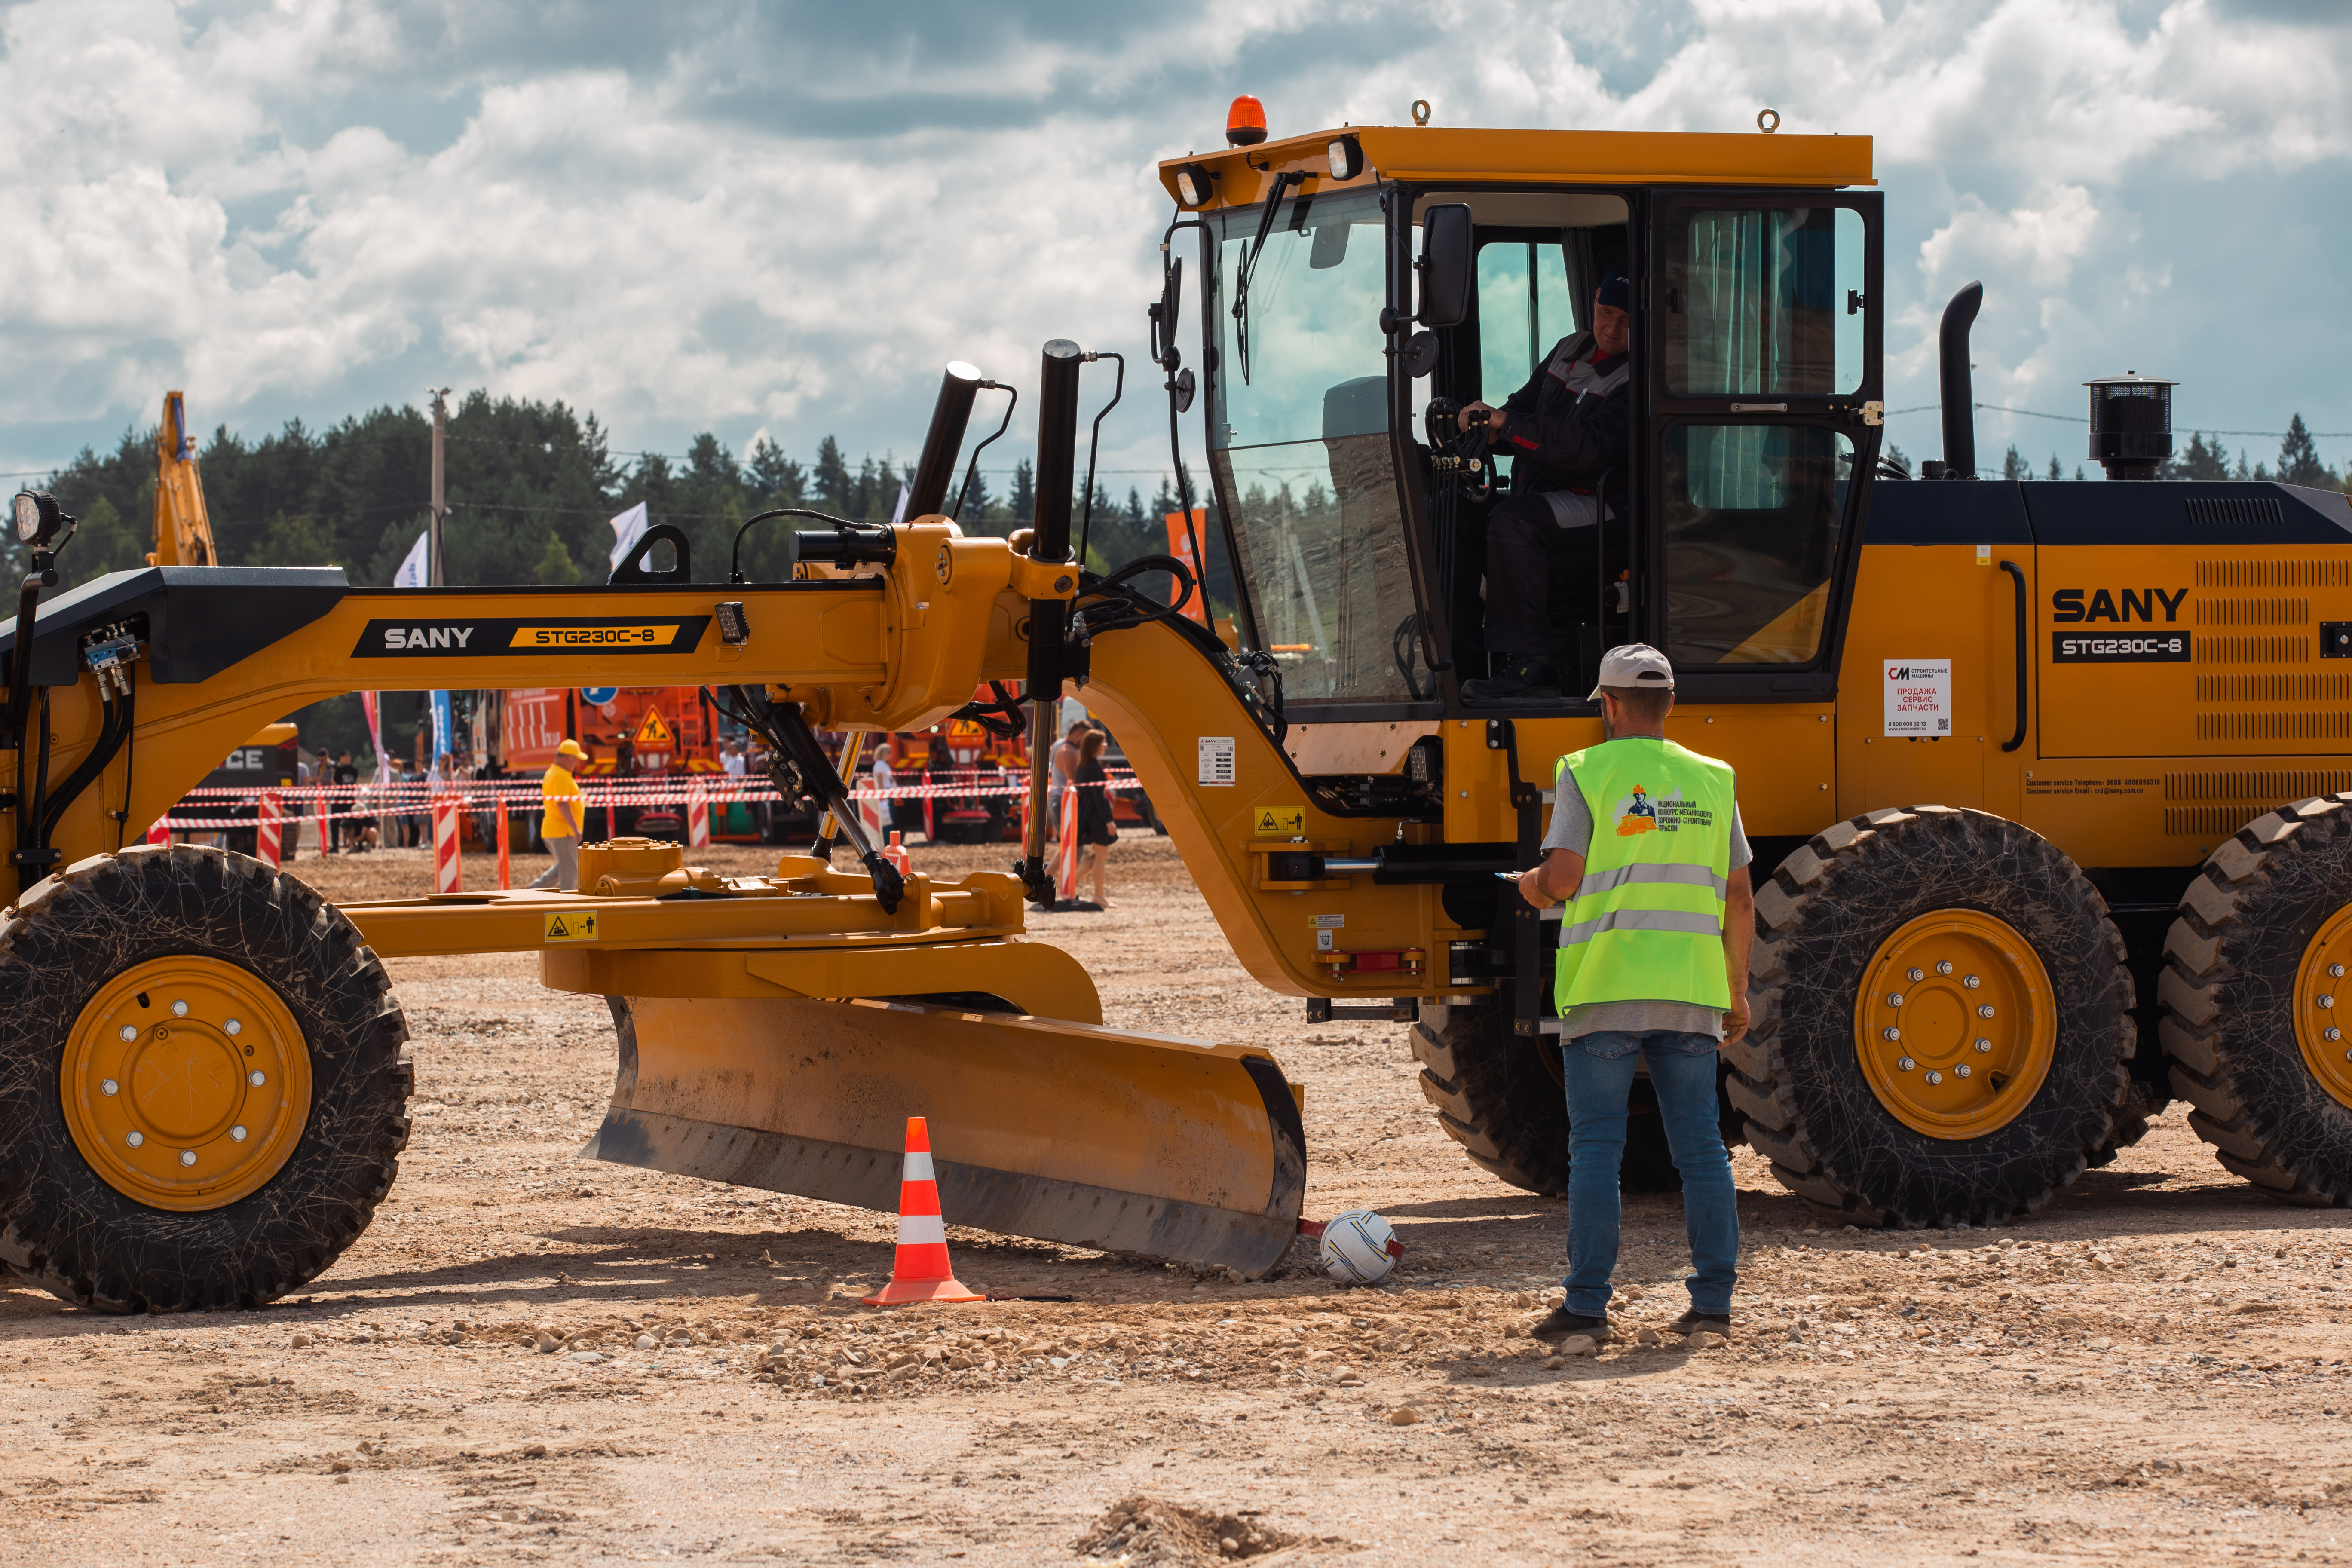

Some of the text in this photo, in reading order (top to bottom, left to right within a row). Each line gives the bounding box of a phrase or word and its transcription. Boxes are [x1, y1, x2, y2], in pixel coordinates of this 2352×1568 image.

[2052, 588, 2189, 622] SANY
[385, 628, 655, 649] SANY STG230C-8
[2062, 639, 2182, 654] STG230C-8
